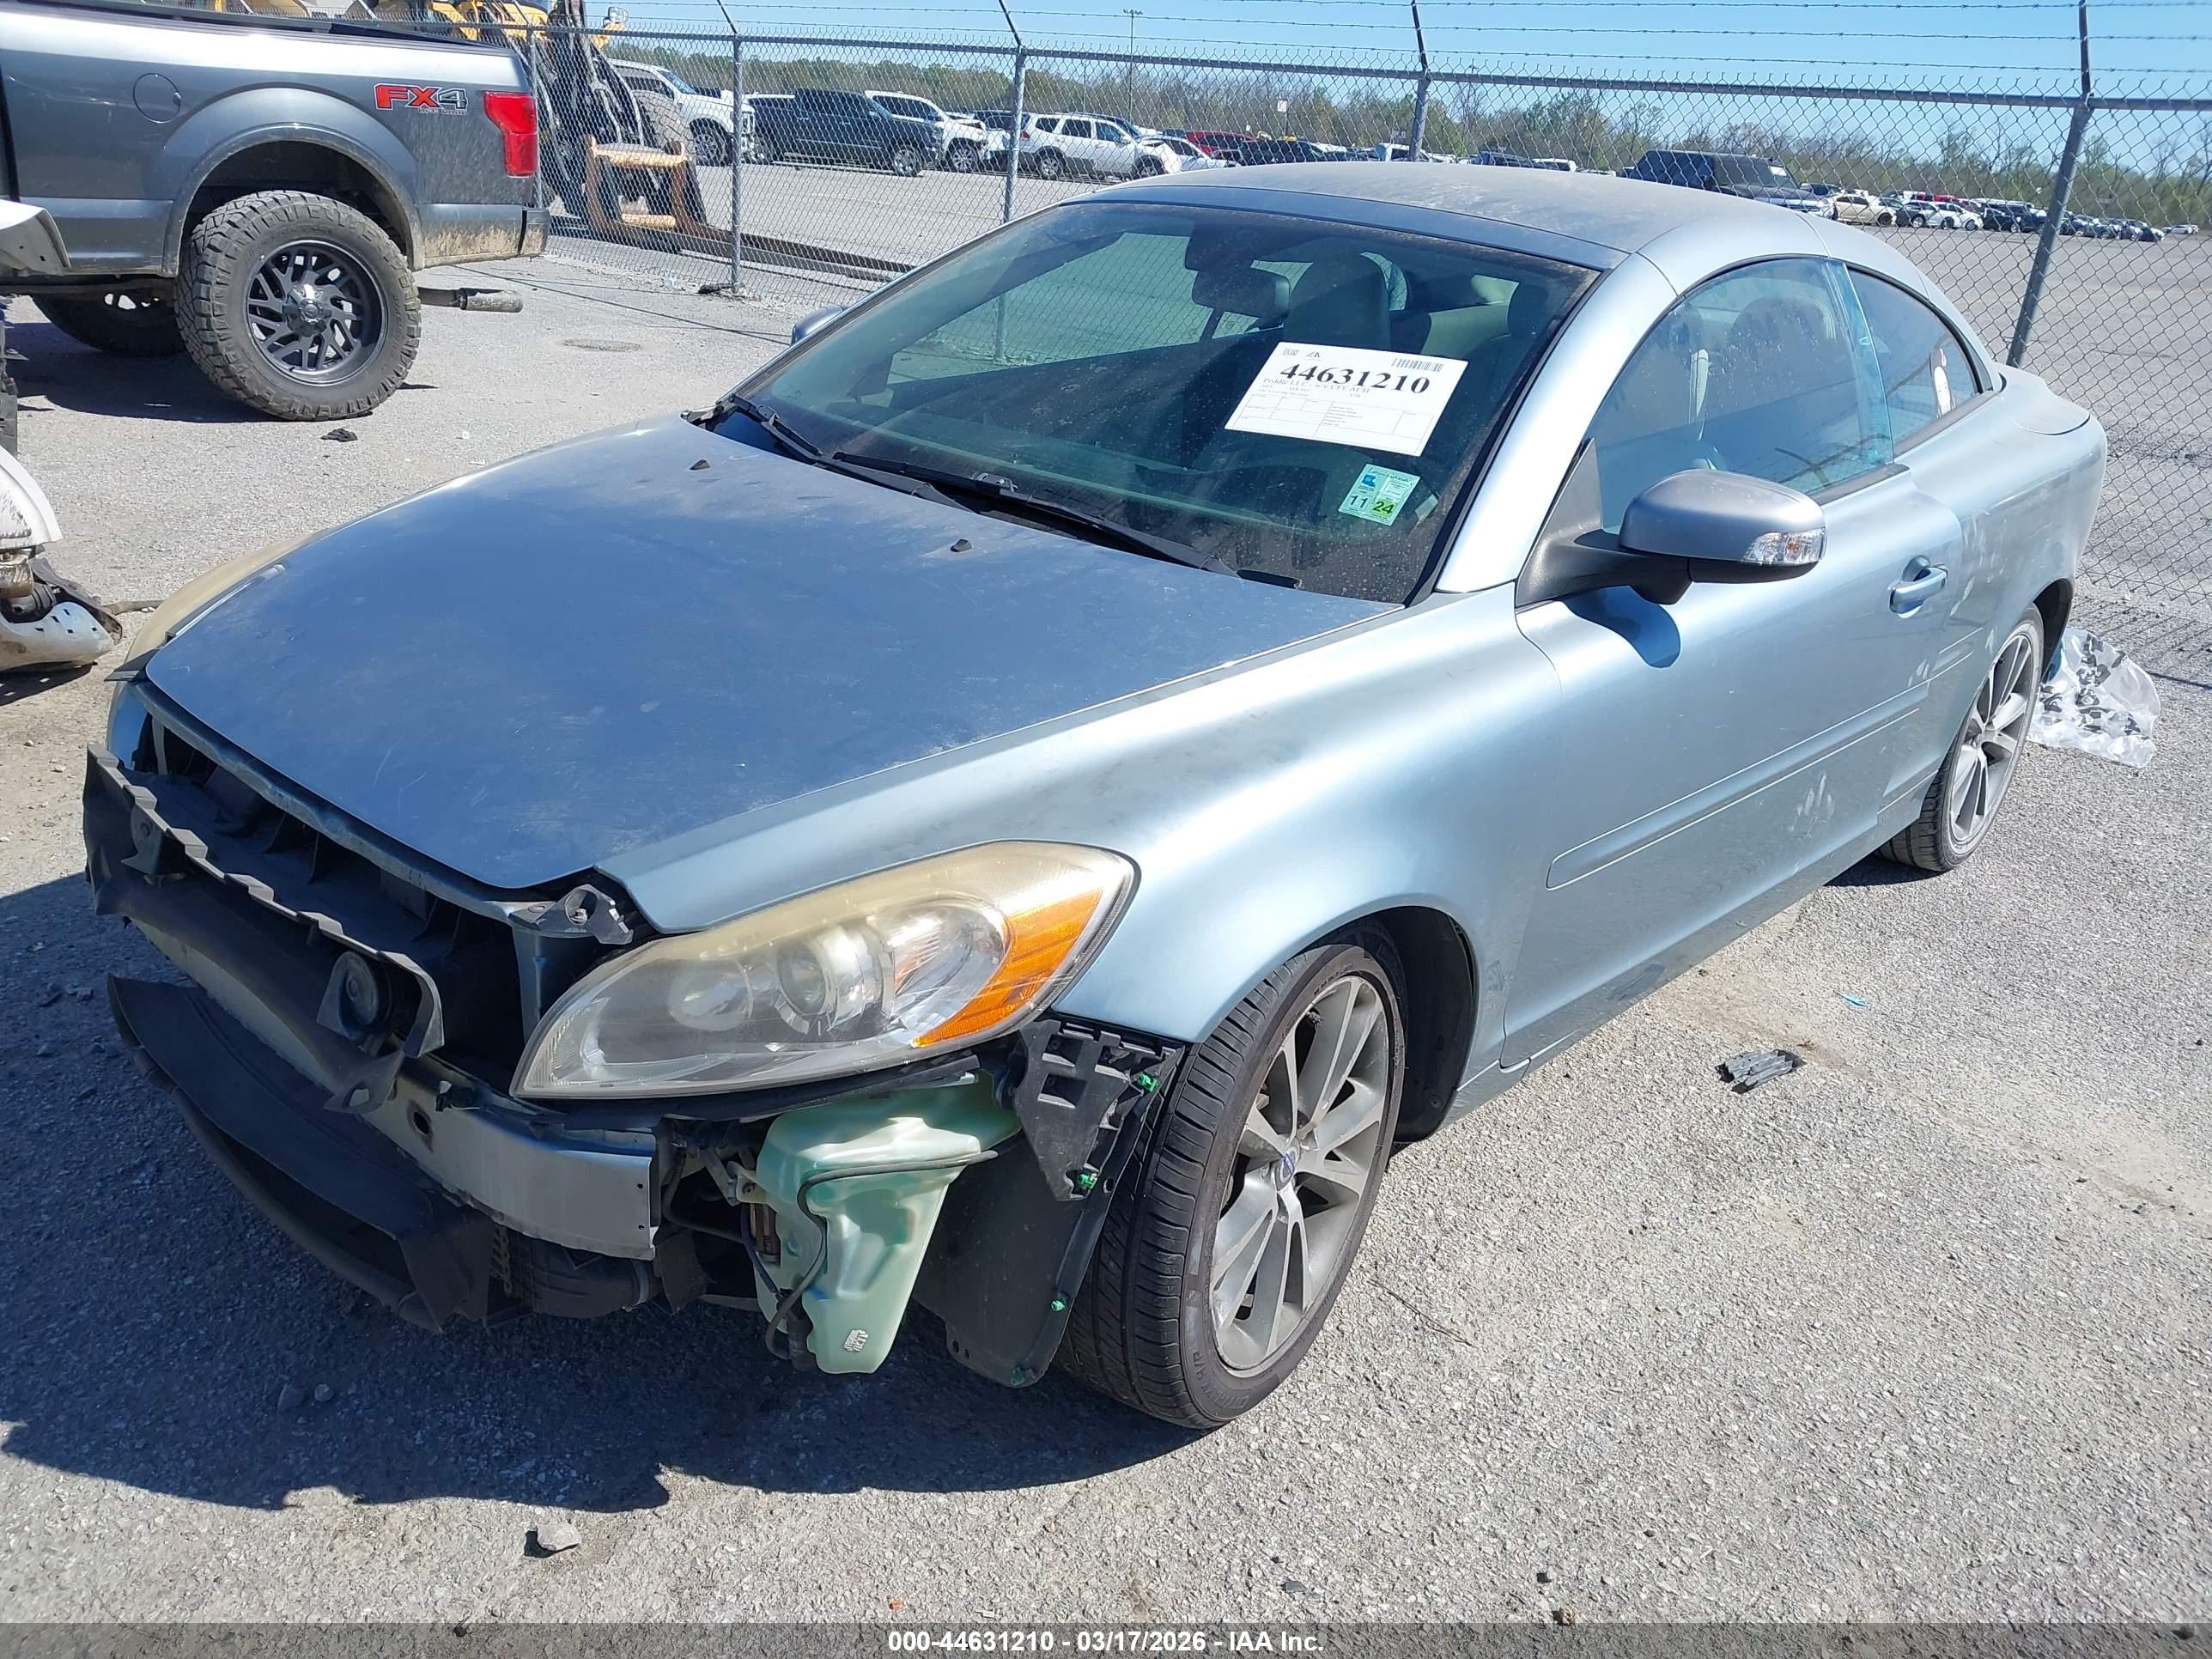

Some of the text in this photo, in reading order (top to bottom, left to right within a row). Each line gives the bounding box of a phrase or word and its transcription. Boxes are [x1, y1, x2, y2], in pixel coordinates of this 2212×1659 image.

[374, 82, 468, 110] FX4
[1279, 363, 1430, 394] 44631210
[1350, 495, 1368, 508] 11
[1373, 501, 1395, 514] 24
